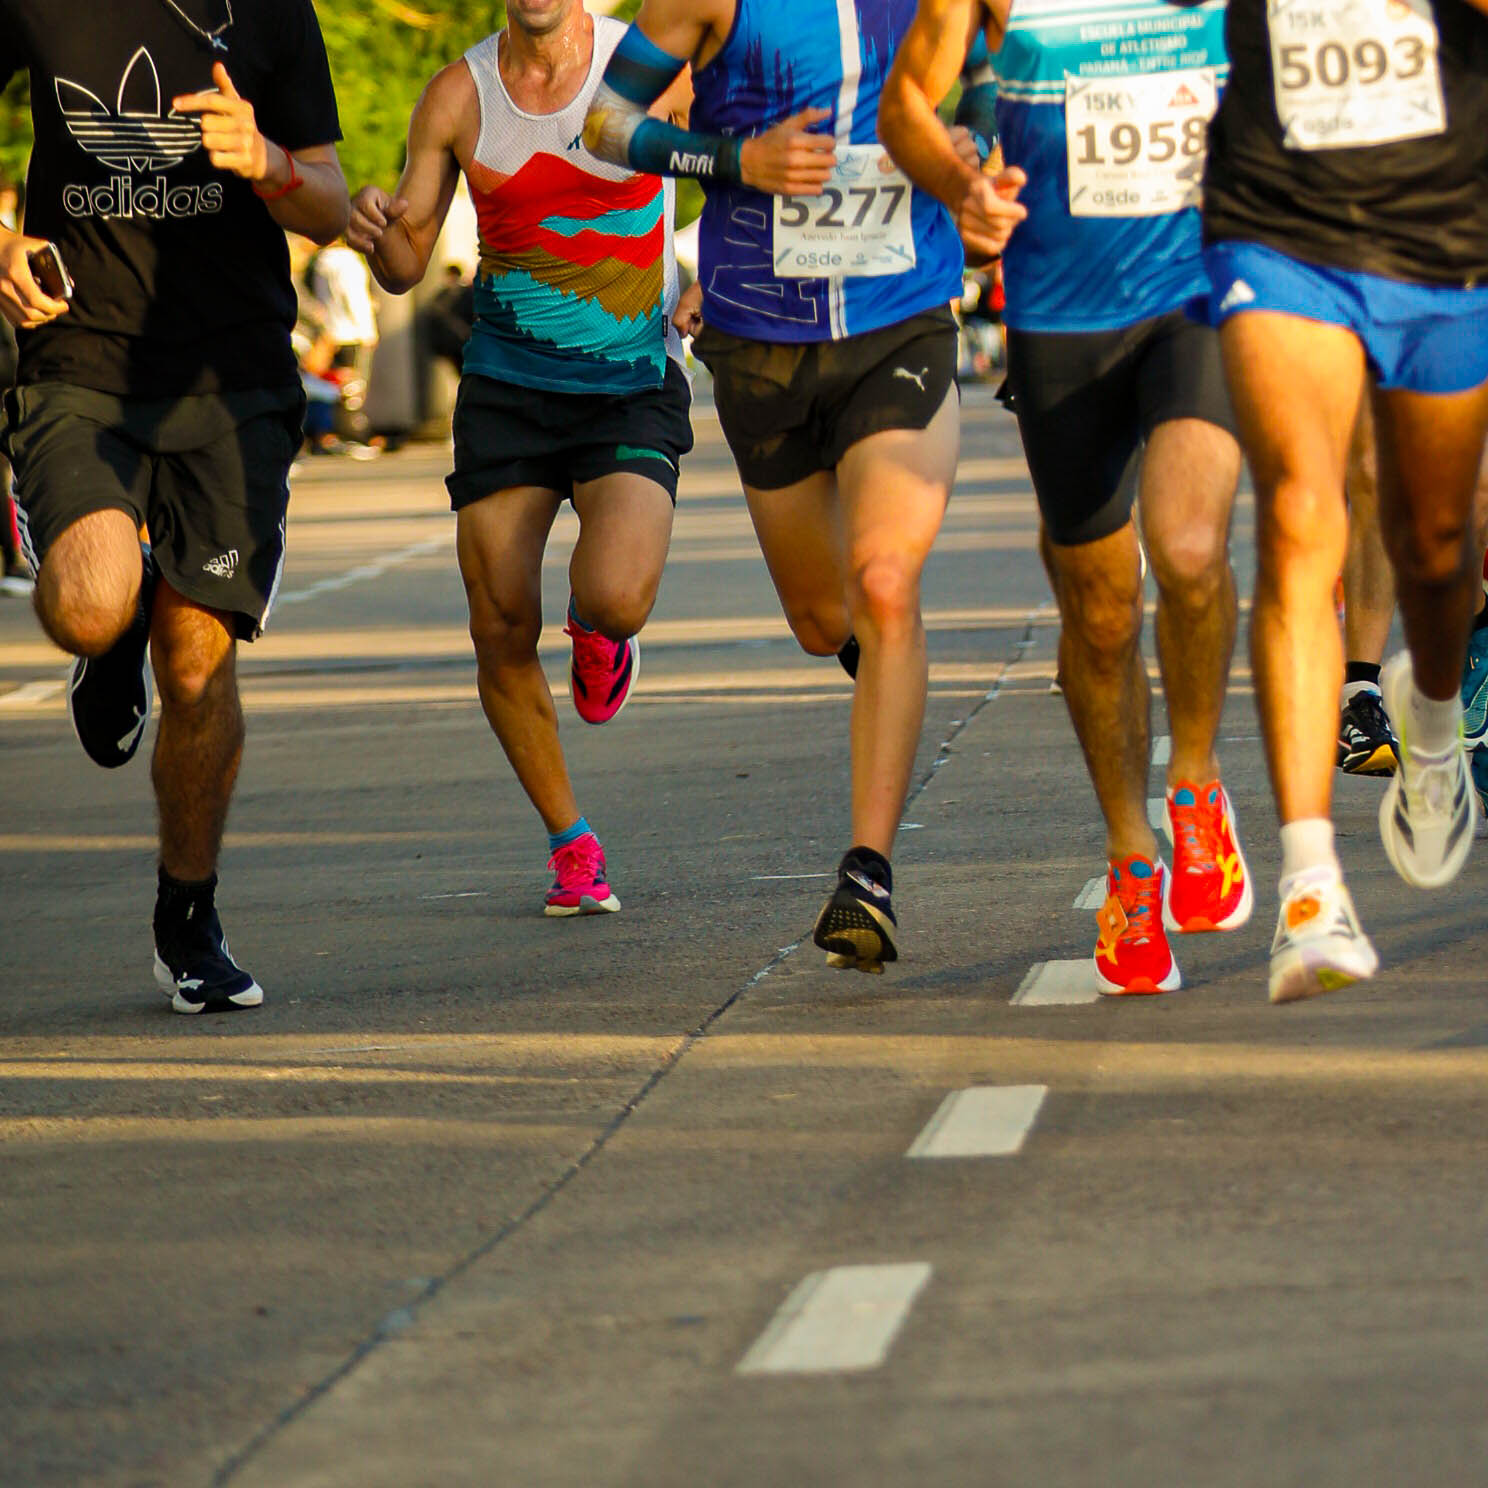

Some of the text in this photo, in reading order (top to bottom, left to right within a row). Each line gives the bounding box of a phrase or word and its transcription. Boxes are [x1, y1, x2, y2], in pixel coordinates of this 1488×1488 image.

[1278, 35, 1425, 90] 5093
[1084, 92, 1122, 111] 15K
[1075, 115, 1208, 165] 1958
[63, 176, 223, 219] adidas
[779, 184, 906, 228] 5277
[1092, 188, 1140, 207] osde
[795, 250, 842, 267] osde
